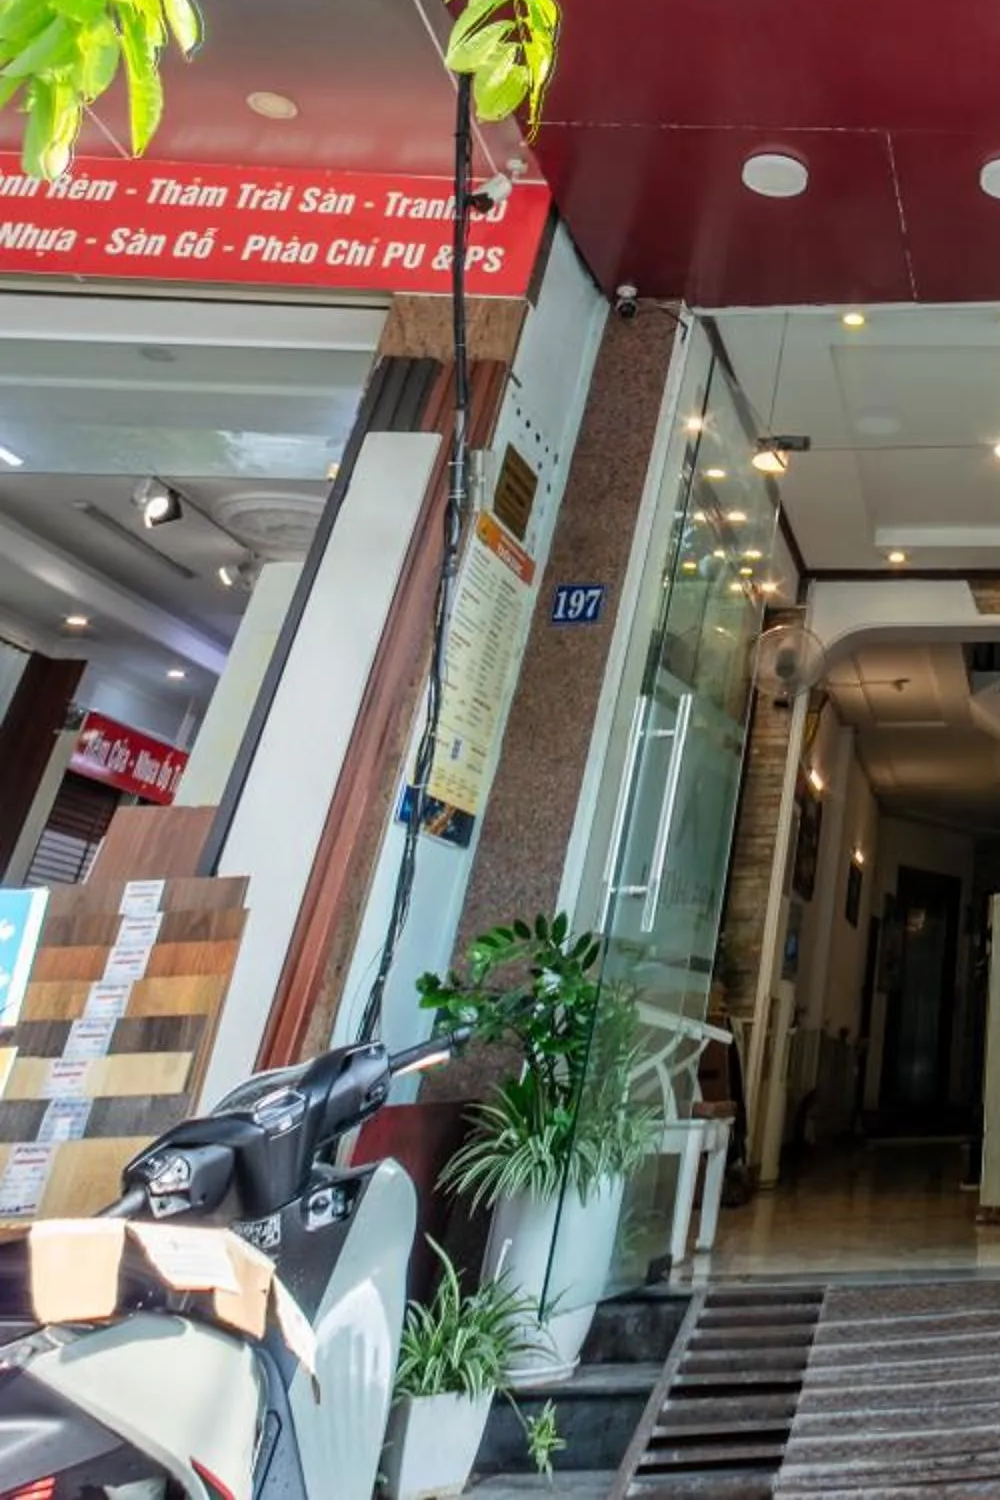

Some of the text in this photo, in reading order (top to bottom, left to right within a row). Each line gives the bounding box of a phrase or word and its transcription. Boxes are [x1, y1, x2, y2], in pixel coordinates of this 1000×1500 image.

[147, 176, 229, 208] Thảm
[237, 181, 294, 212] Trải
[299, 186, 356, 215] Sàn
[0, 221, 78, 258] Nhựa
[104, 227, 167, 256] Sàn
[172, 227, 220, 260] Gỗ
[240, 234, 319, 265] Phào
[382, 240, 426, 270] PU
[464, 245, 506, 274] PS
[553, 588, 603, 620] 197
